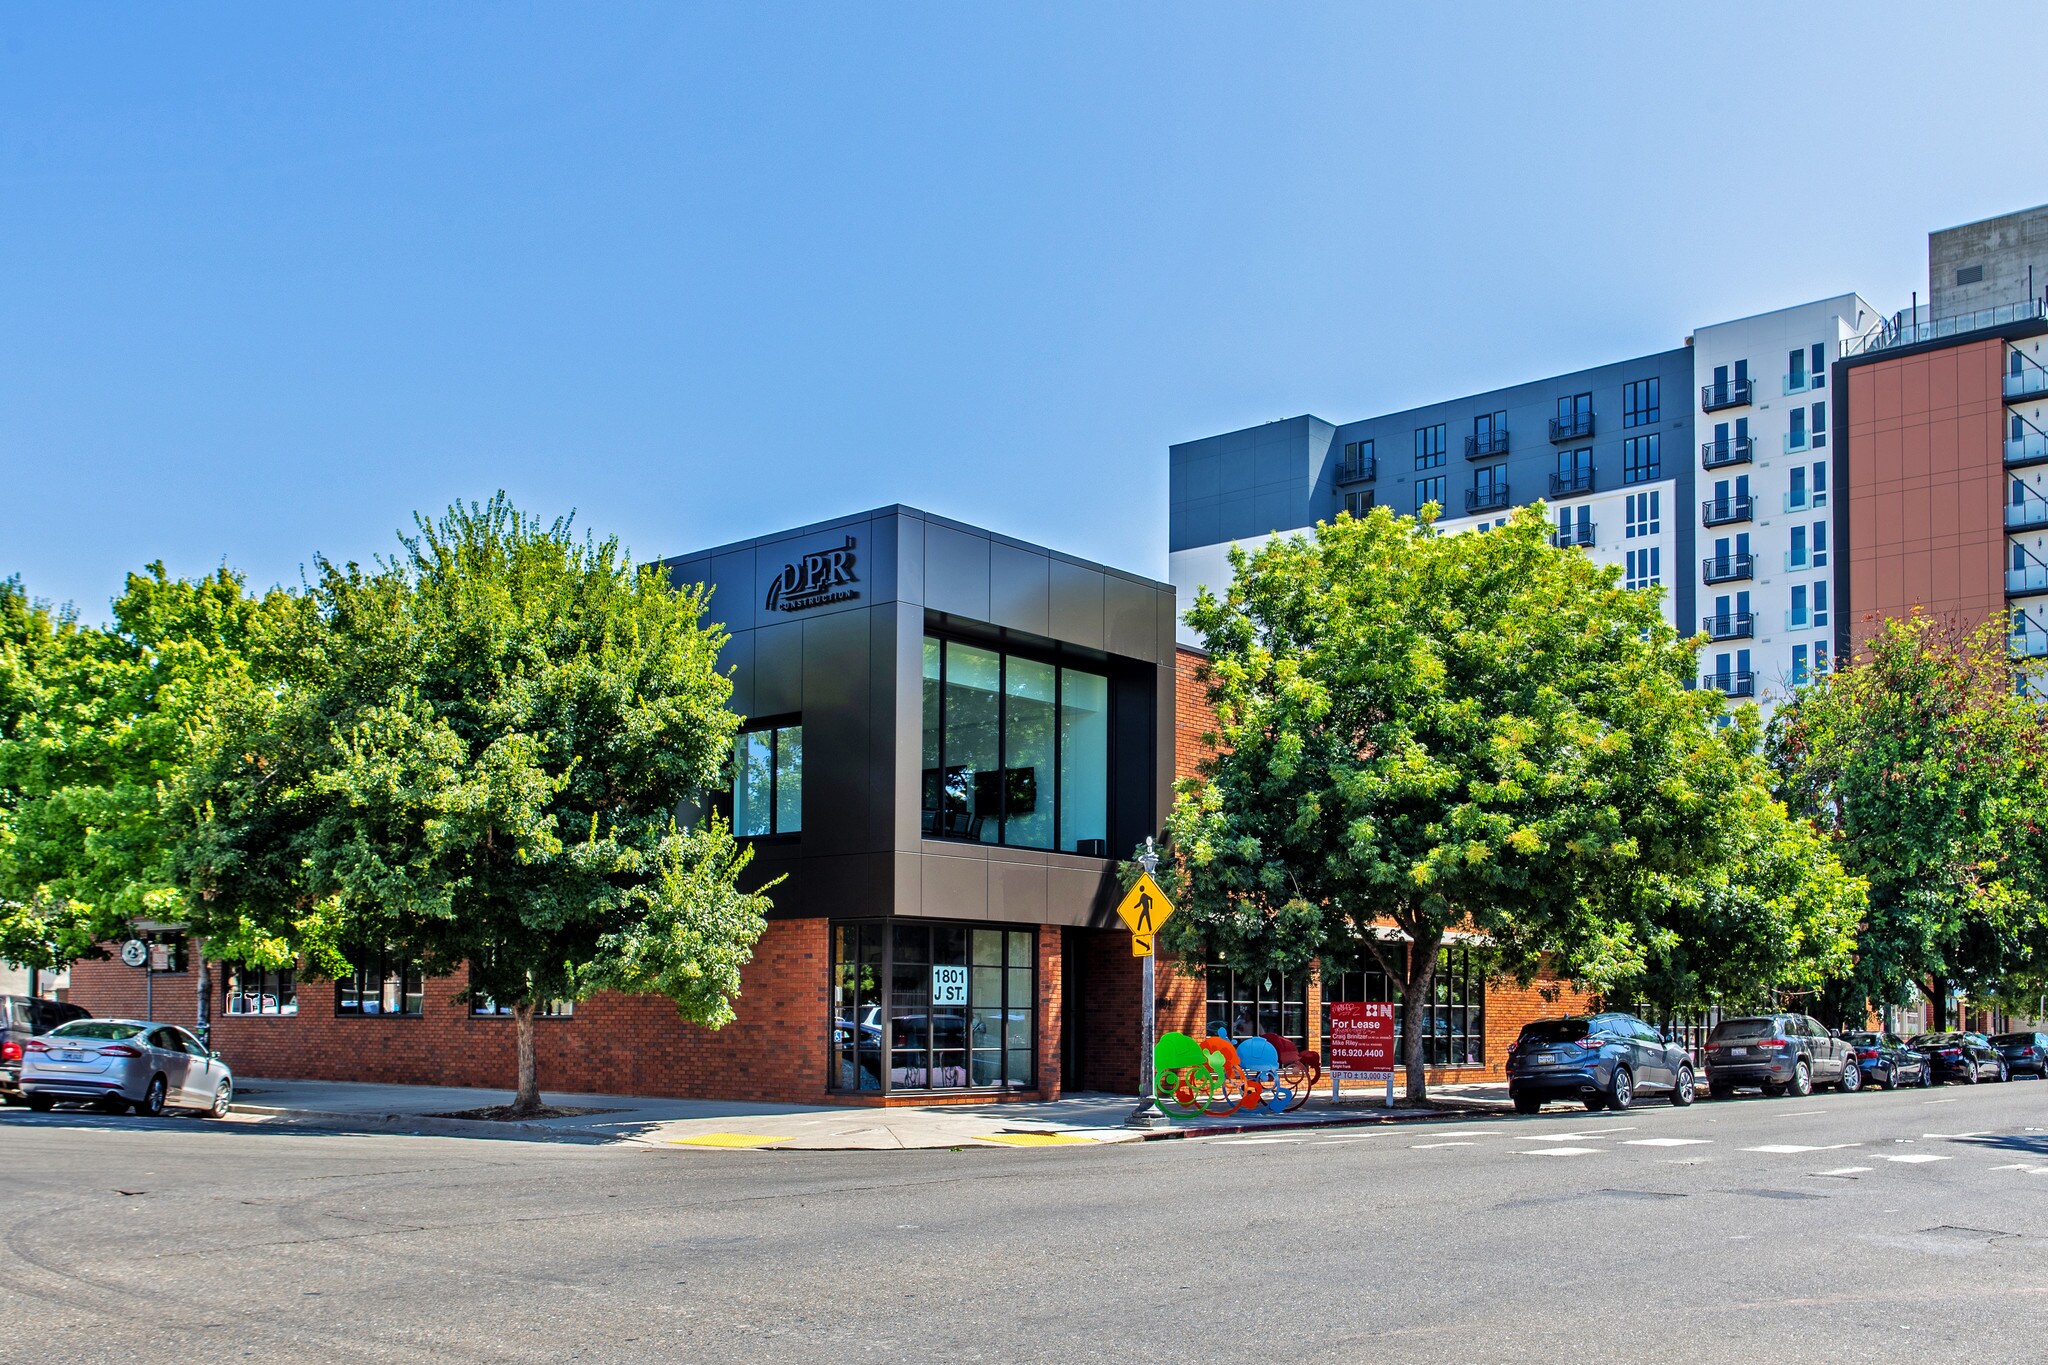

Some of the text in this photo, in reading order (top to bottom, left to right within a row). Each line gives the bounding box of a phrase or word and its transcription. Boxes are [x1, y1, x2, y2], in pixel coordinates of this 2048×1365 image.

[778, 550, 852, 594] DPR
[779, 590, 852, 610] CONSTRUCTION
[935, 969, 964, 983] 1801
[934, 986, 964, 1000] J ST.
[1332, 1019, 1380, 1028] For Lease
[1332, 1049, 1384, 1057] 916.920.4400
[1332, 1071, 1342, 1079] UP
[1360, 1072, 1381, 1080] 13,000
